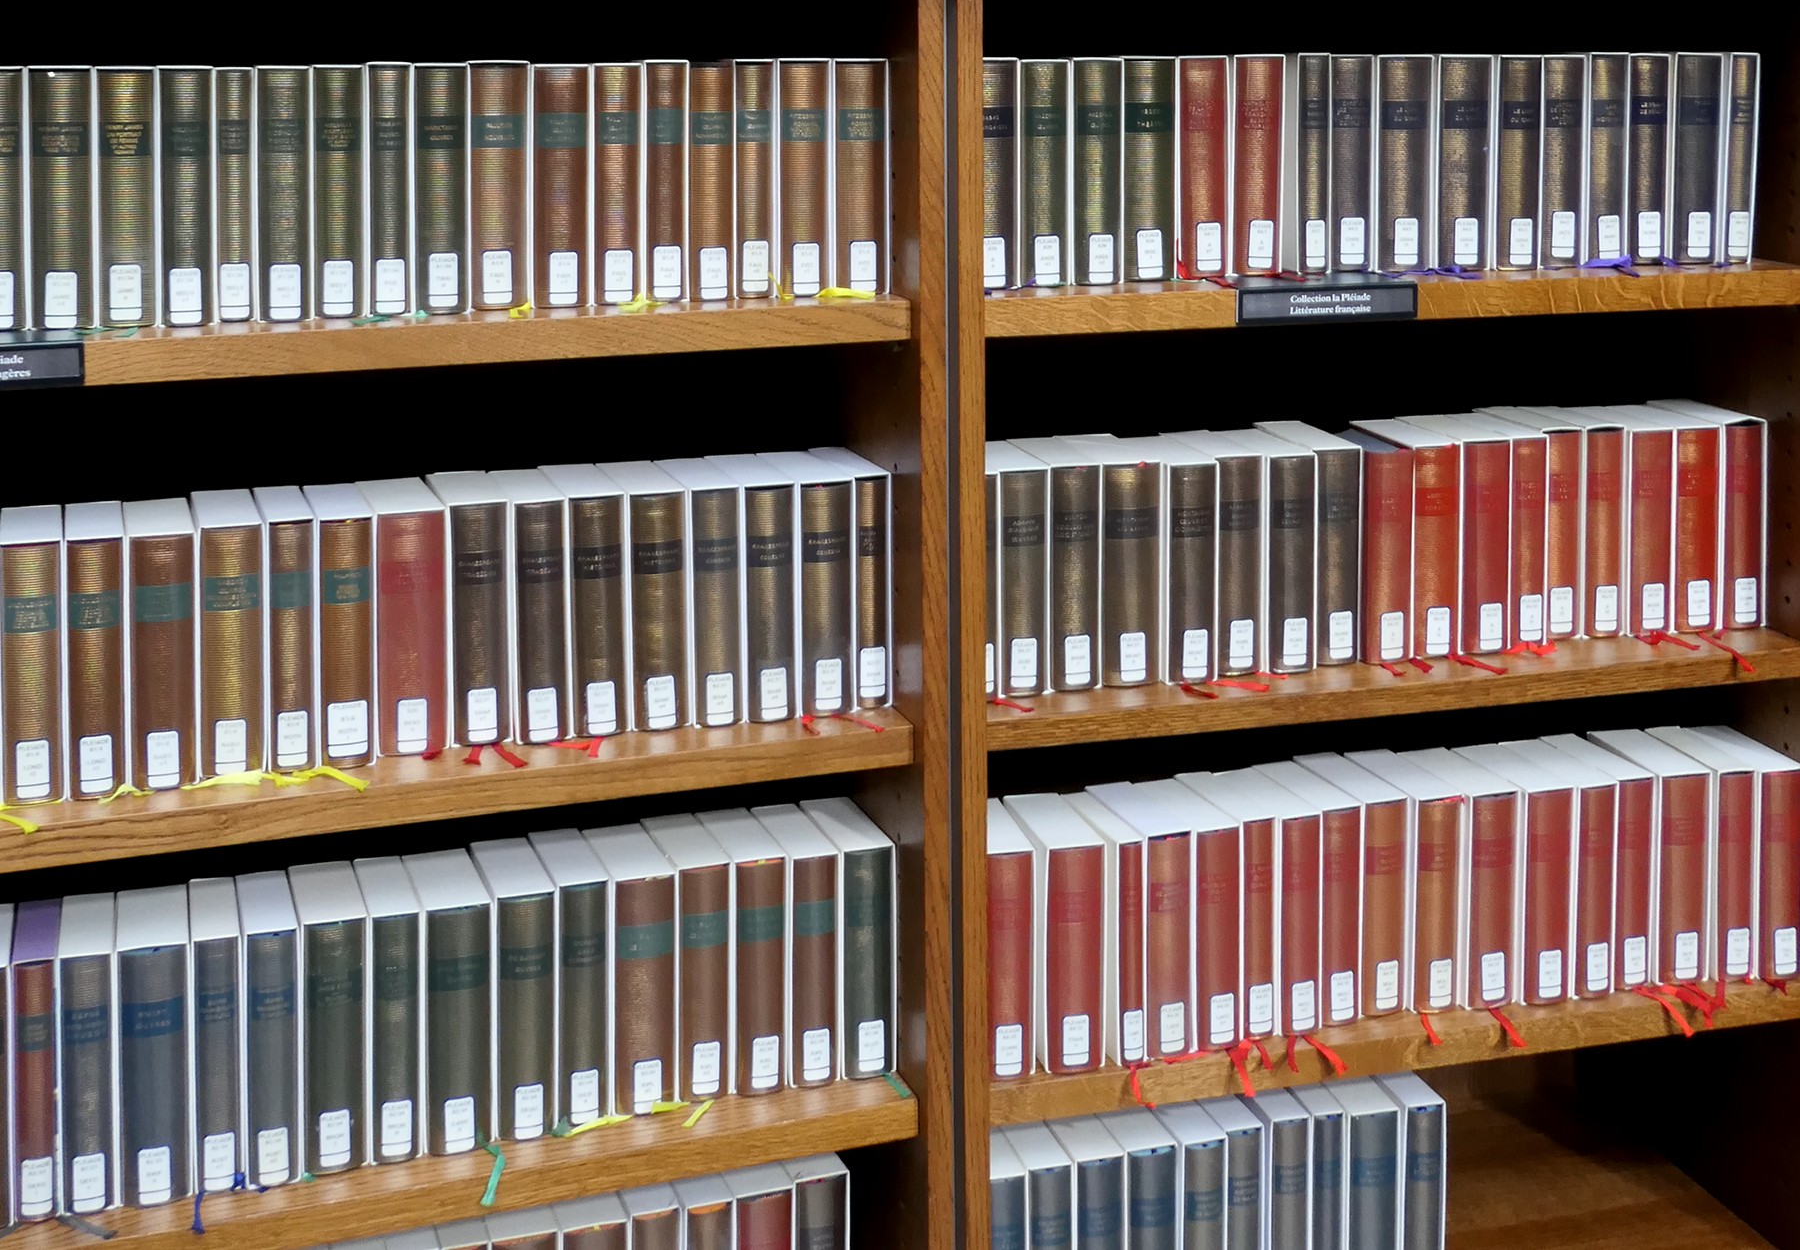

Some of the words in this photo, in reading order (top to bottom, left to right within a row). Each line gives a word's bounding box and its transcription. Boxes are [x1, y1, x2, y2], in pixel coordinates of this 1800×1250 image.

[1290, 293, 1331, 304] Collection
[1332, 293, 1340, 302] la
[1341, 292, 1371, 302] Pléiade
[1289, 306, 1334, 315] Littérature
[1335, 304, 1371, 315] française
